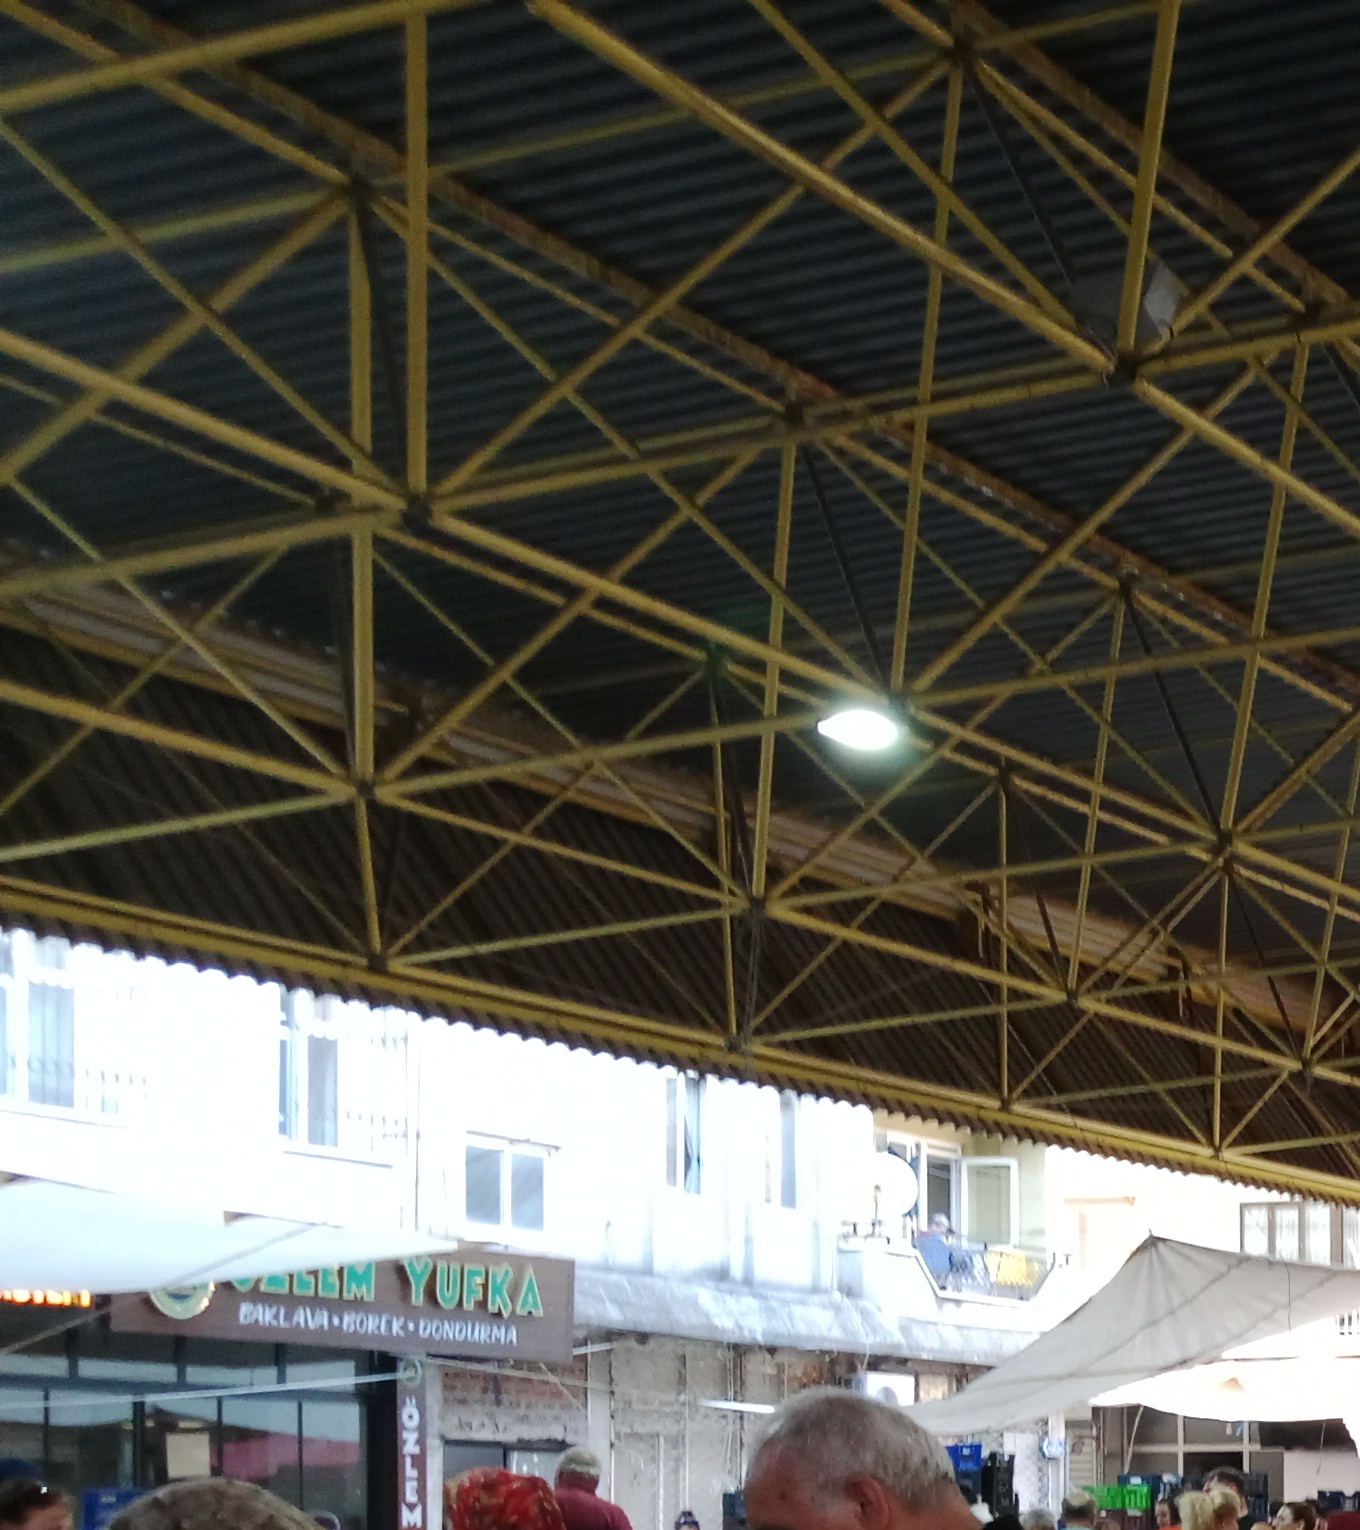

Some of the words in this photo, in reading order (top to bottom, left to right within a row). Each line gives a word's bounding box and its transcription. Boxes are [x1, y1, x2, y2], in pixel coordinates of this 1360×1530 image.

[404, 1256, 544, 1318] YUFKA
[239, 1303, 329, 1330] BAKLAVA
[419, 1317, 518, 1346] DONDURMA
[401, 1395, 422, 1529] ÖZLEM
